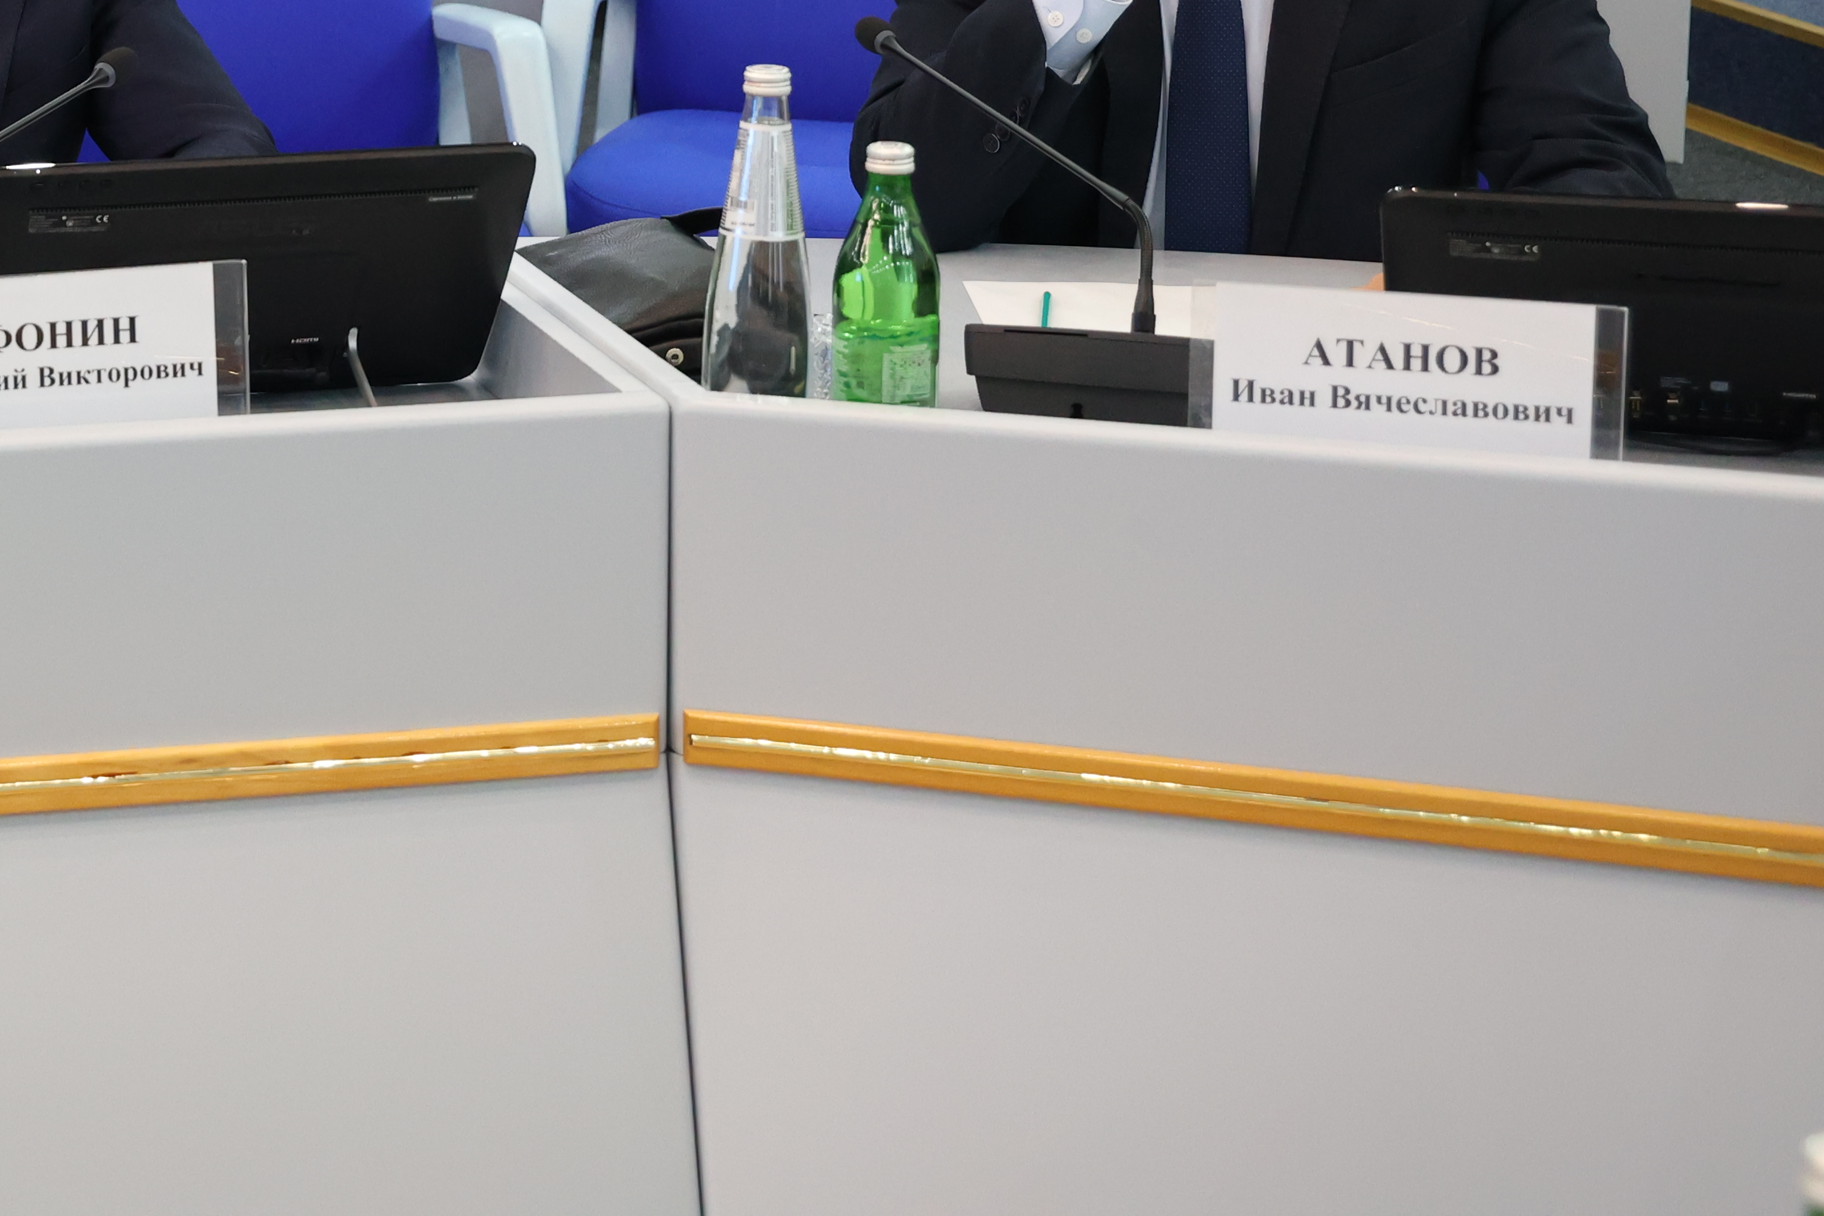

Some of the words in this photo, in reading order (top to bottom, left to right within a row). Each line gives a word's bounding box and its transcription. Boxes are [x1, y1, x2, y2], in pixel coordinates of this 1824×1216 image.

[37, 360, 205, 389] Викторович
[1302, 336, 1501, 377] АТАНОВ
[1230, 377, 1318, 409] Иван
[1329, 384, 1575, 425] Вячеславович
